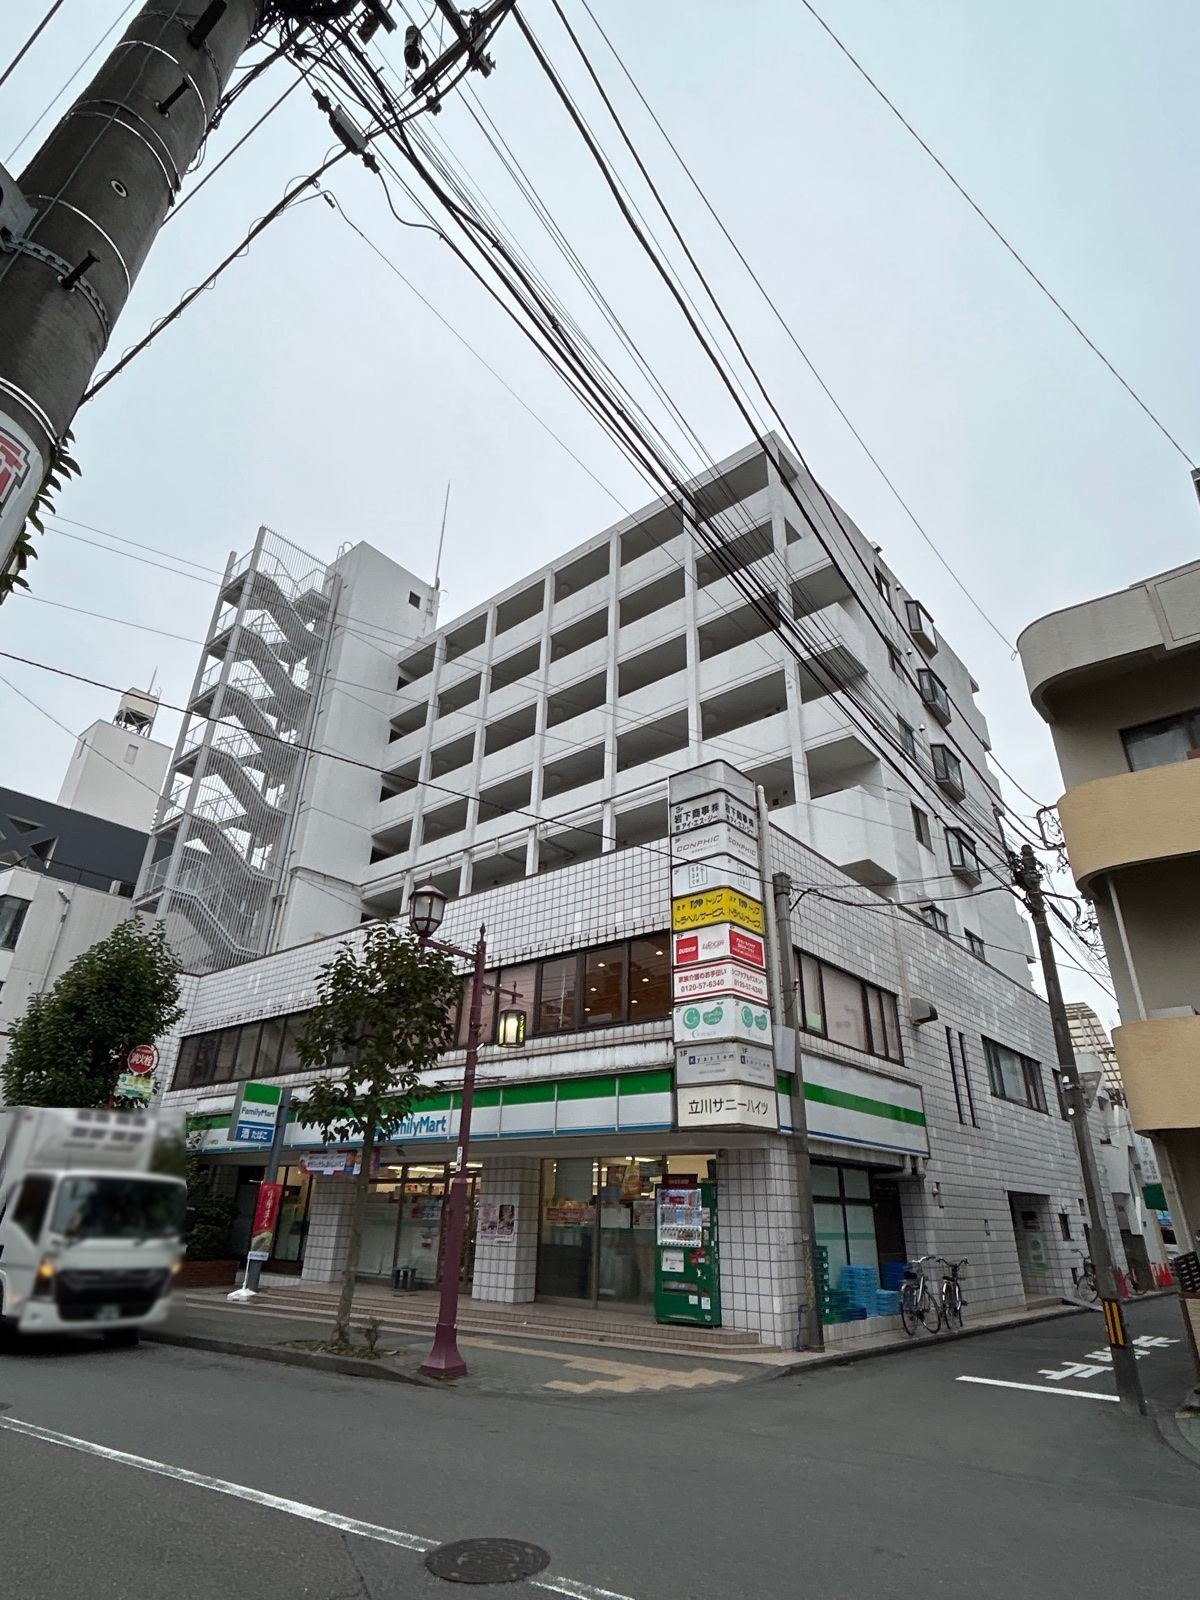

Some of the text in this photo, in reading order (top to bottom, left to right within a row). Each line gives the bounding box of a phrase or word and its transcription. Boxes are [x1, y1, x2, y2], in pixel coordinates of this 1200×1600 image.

[676, 834, 720, 853] CONPHIC
[680, 979, 725, 993] 0120-57-6340
[131, 1052, 153, 1067] 消火栓
[241, 1106, 276, 1118] FamilyMart
[688, 1098, 768, 1115] 立川サニーハイツ
[241, 1127, 269, 1140] 酒 たばこ
